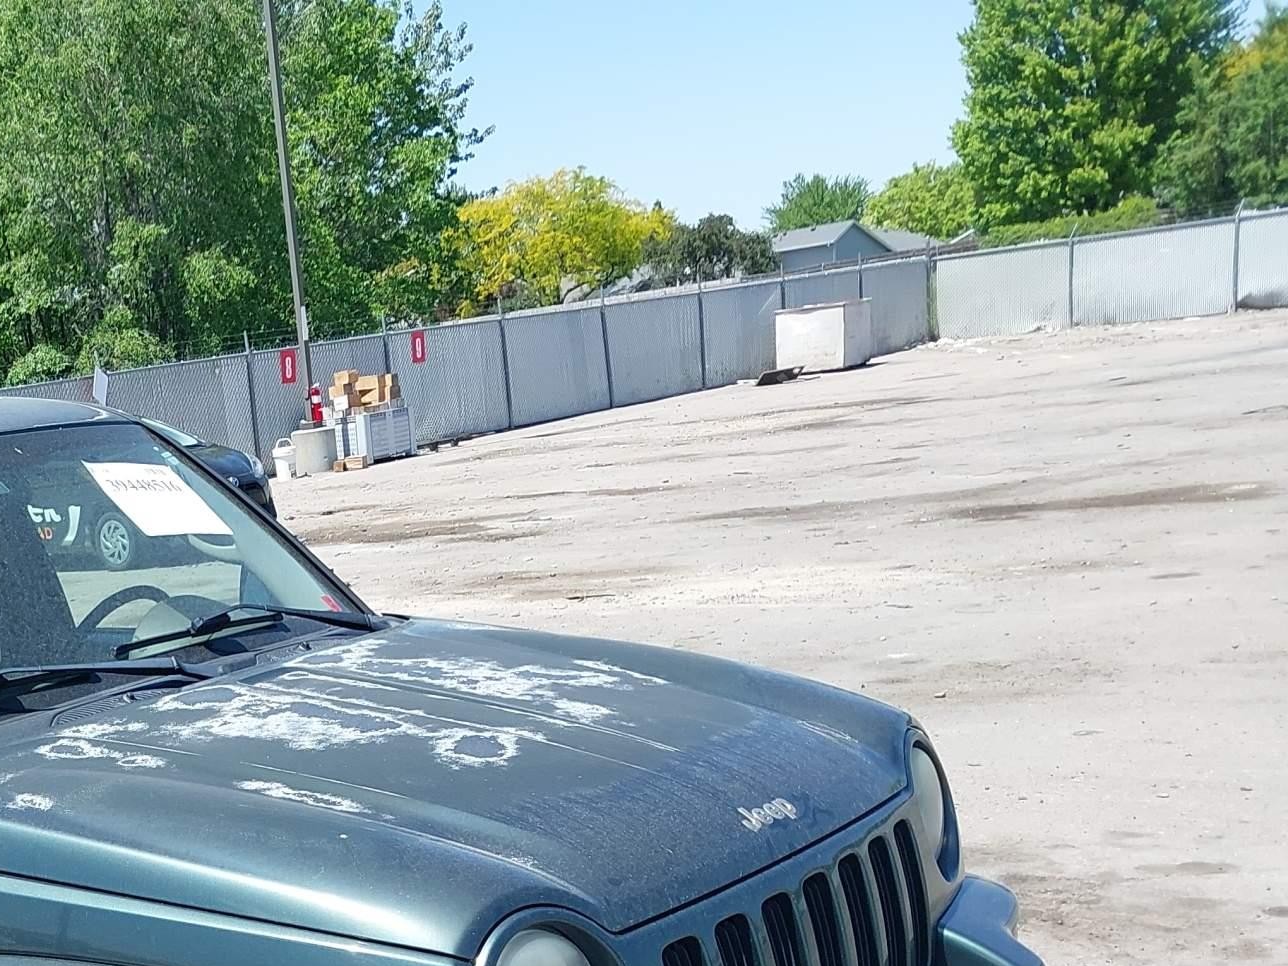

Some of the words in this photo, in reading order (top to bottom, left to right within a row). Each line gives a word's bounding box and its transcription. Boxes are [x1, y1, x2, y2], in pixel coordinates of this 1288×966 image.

[285, 356, 293, 379] 8
[105, 479, 183, 492] 39448516
[737, 798, 797, 832] Jeep
